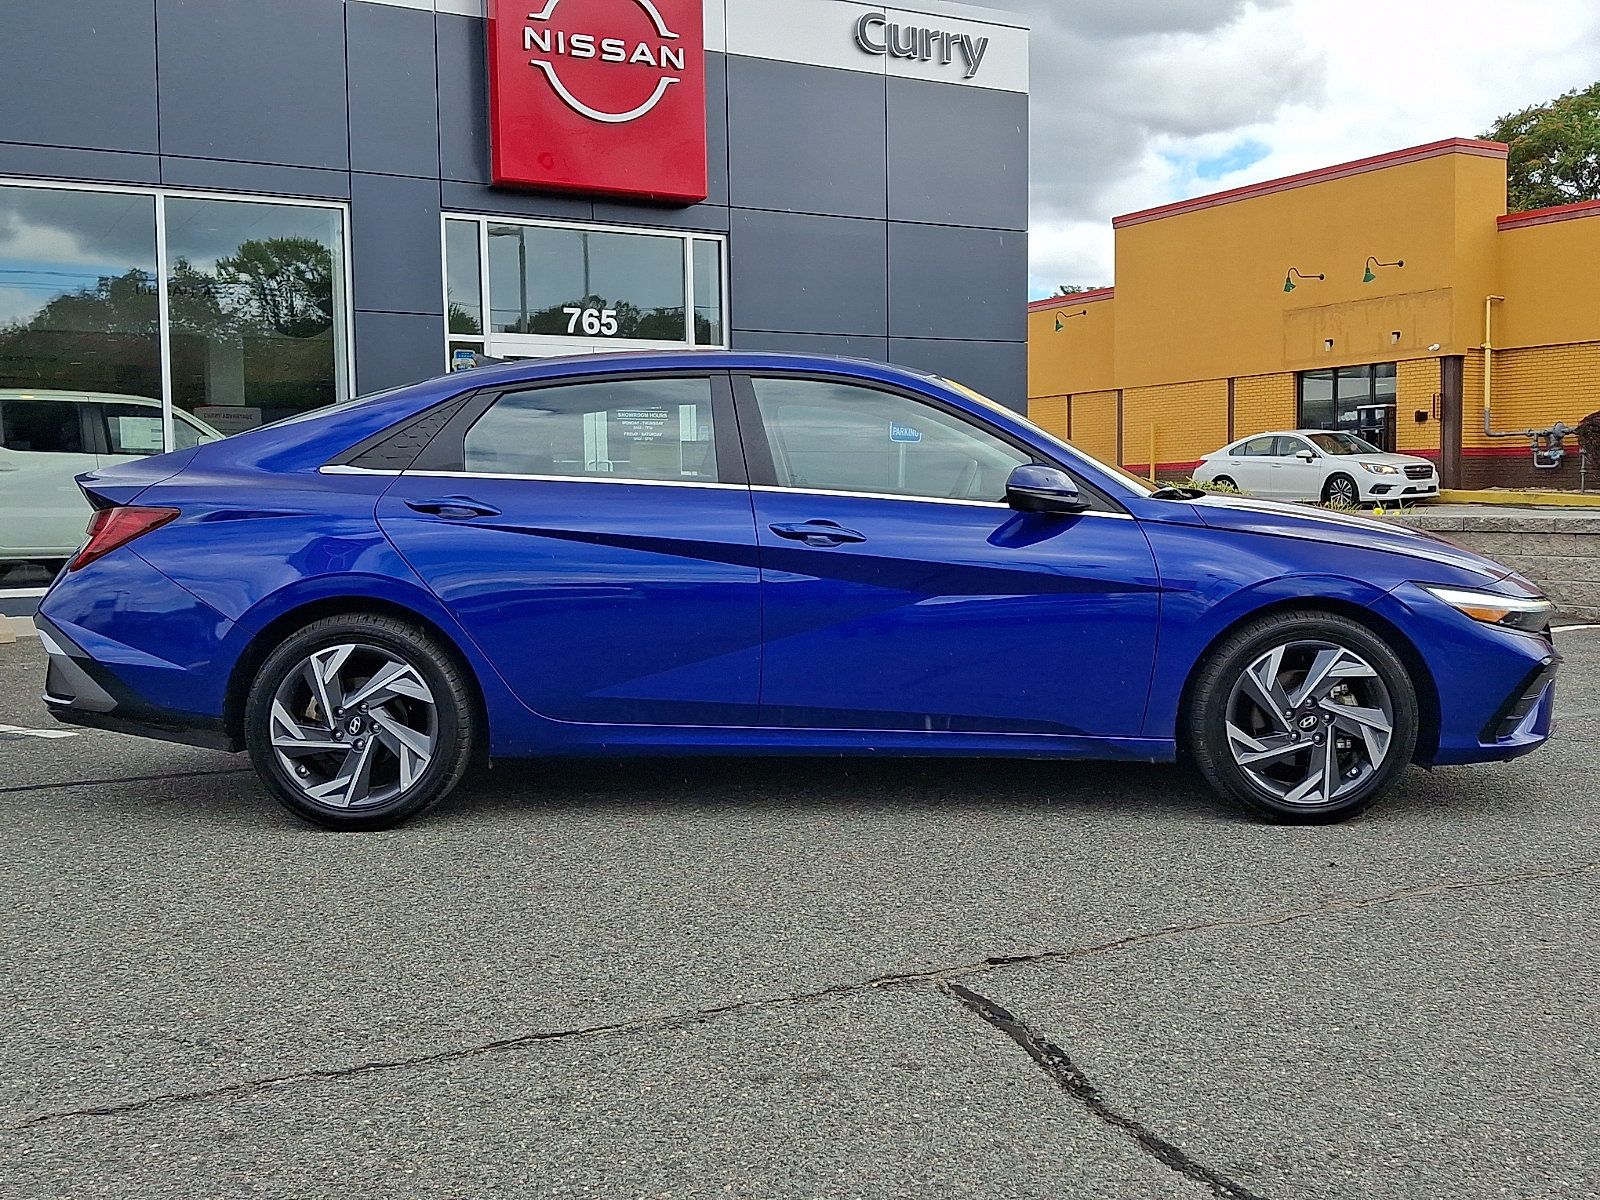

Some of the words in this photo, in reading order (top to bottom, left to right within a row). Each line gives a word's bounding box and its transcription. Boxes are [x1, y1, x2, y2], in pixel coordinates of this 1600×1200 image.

[523, 26, 685, 70] NISSAN
[855, 11, 990, 78] Curry
[562, 307, 618, 336] 765
